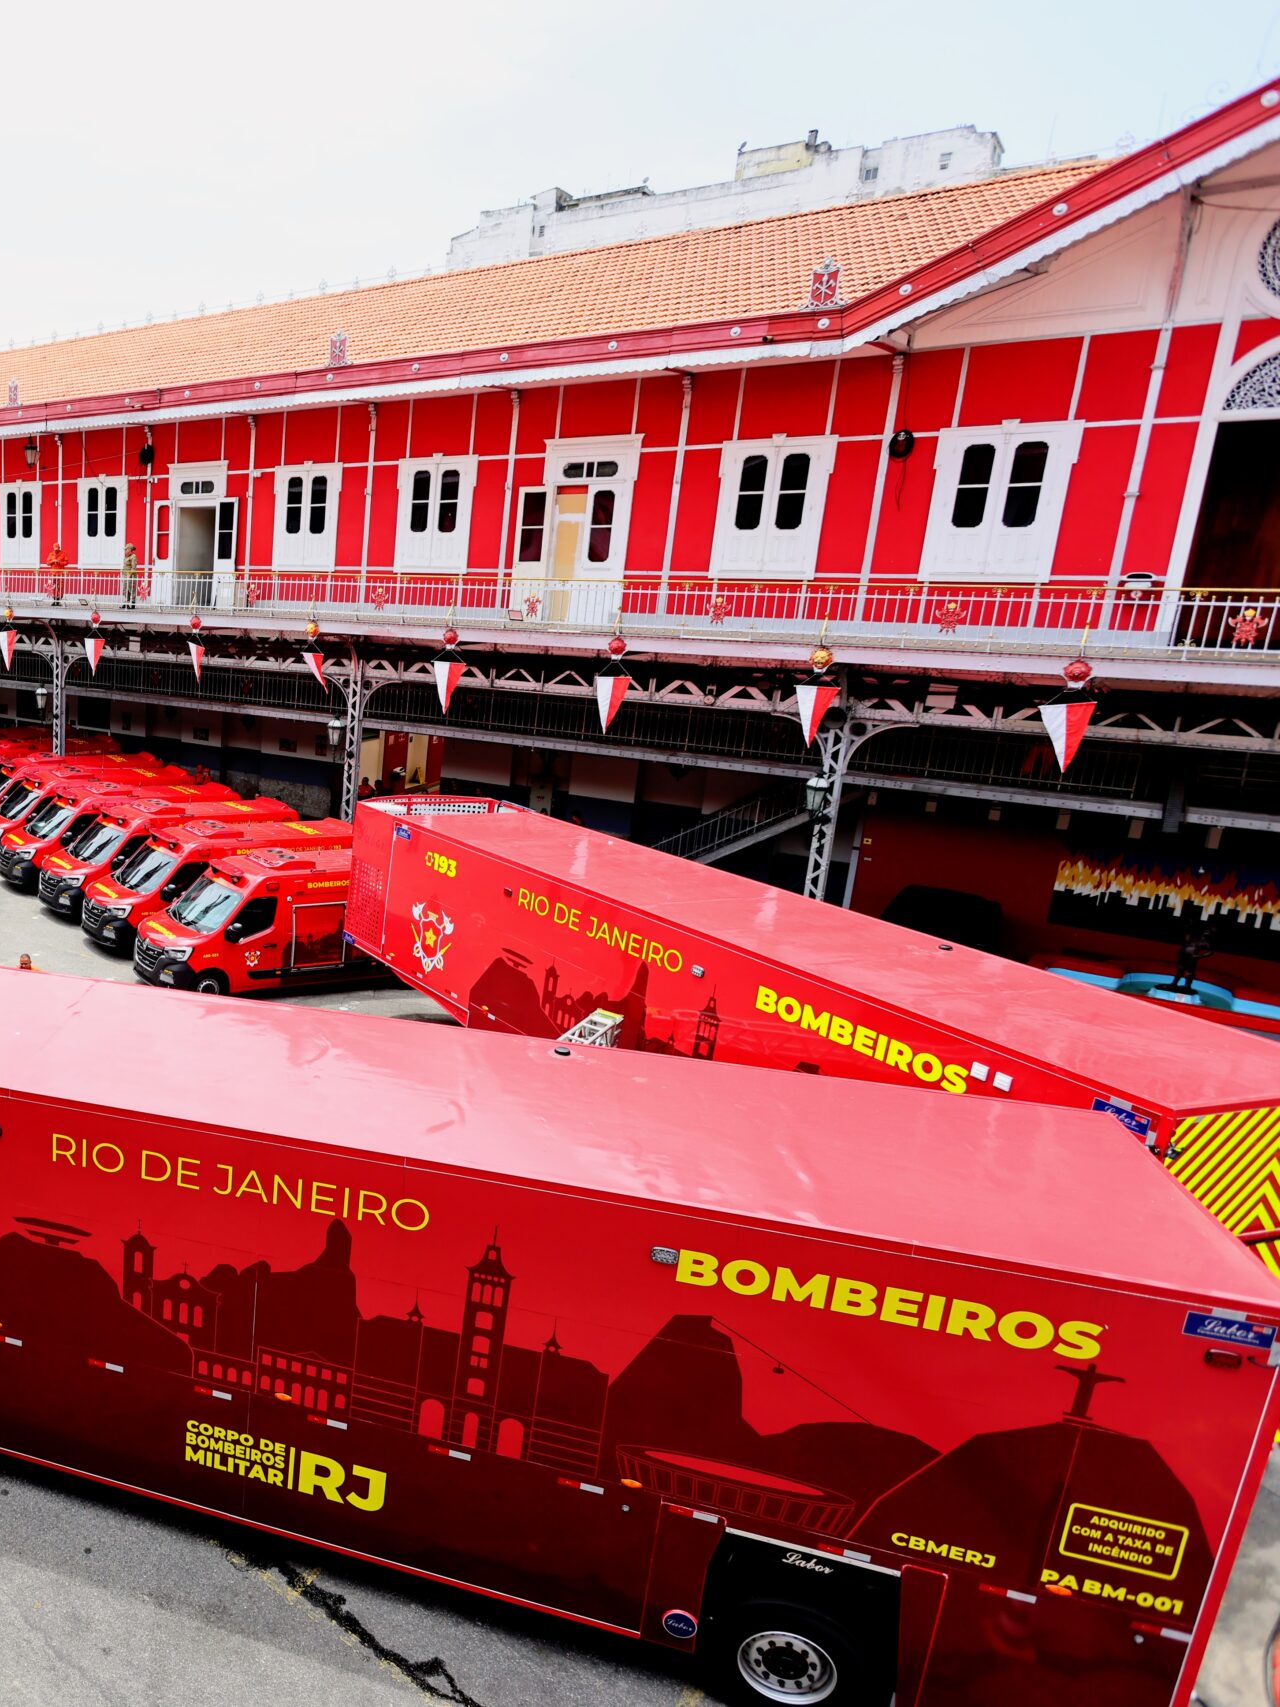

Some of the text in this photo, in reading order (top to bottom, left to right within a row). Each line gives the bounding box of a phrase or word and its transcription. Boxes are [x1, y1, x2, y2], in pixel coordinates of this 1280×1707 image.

[433, 851, 457, 878] 193
[307, 880, 350, 889] BOMBEIROS
[518, 887, 683, 973] RIO DE JANEIRO
[755, 985, 969, 1094] BOMBEIROS
[51, 1132, 430, 1232] RIO DE JANEIRO
[675, 1248, 1104, 1360] BOMBEIROS
[1200, 1319, 1255, 1339] Labor
[185, 1431, 285, 1469] BOMBEIROS
[186, 1420, 286, 1456] CORPO DE
[185, 1445, 284, 1487] MILITAR
[298, 1450, 387, 1512] RJ
[1072, 1525, 1174, 1557] COM A TAXA DE
[1090, 1515, 1166, 1540] ADQUIRIDO
[782, 1551, 834, 1575] Labor
[891, 1532, 996, 1568] CBMERJ
[1088, 1542, 1153, 1566] INCÊNDIO
